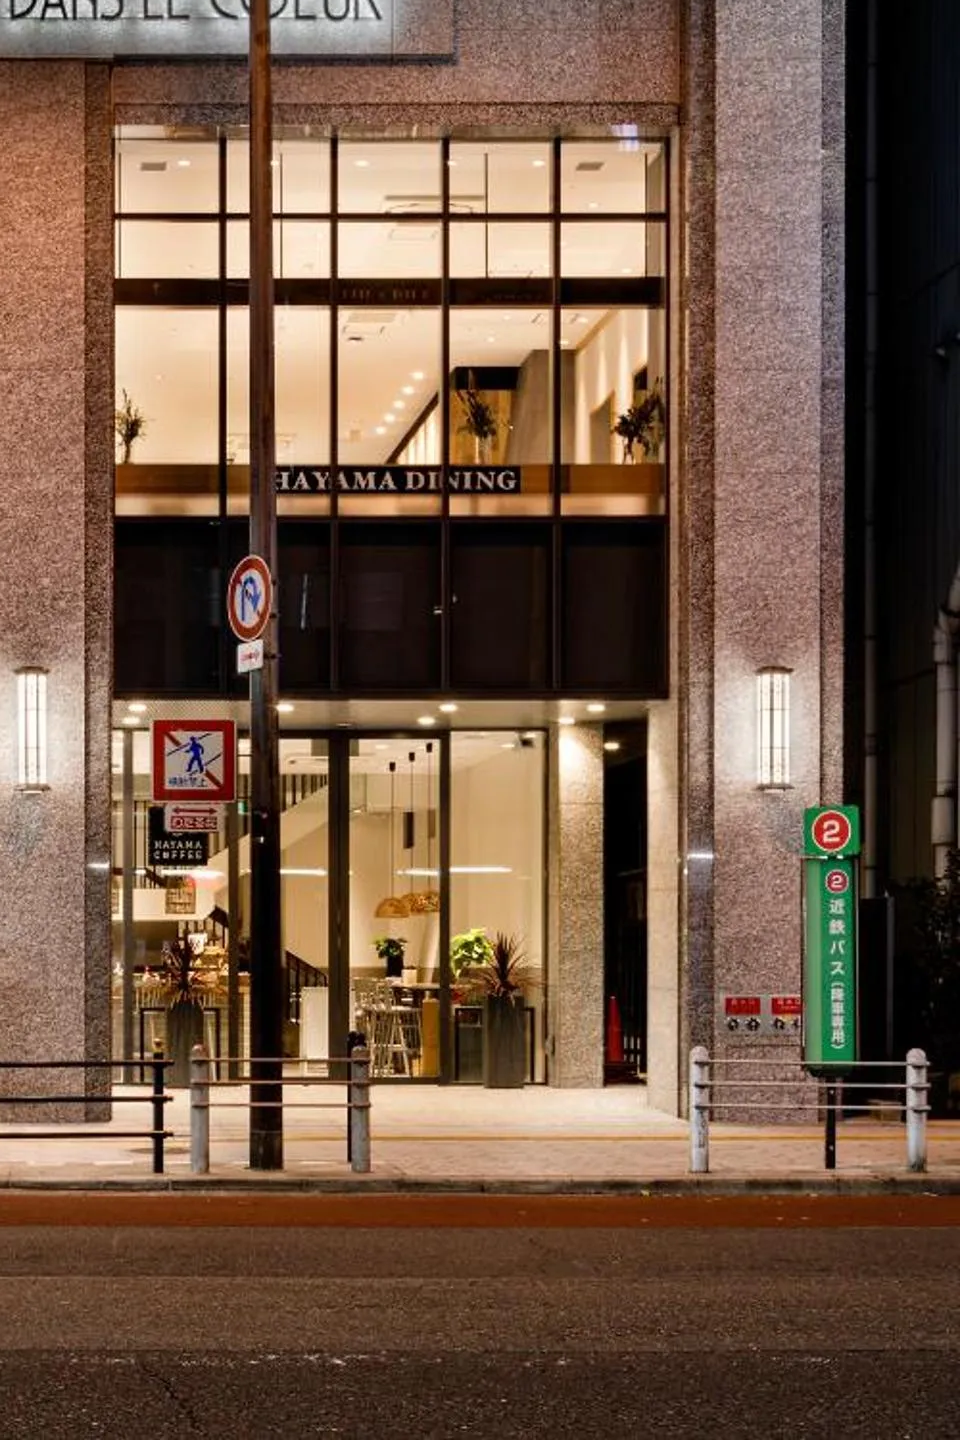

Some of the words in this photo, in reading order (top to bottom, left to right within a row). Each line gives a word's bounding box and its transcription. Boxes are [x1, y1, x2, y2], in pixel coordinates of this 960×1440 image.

[406, 469, 517, 491] DINING
[154, 840, 203, 849] HAYAMA
[153, 850, 203, 859] COFFEE
